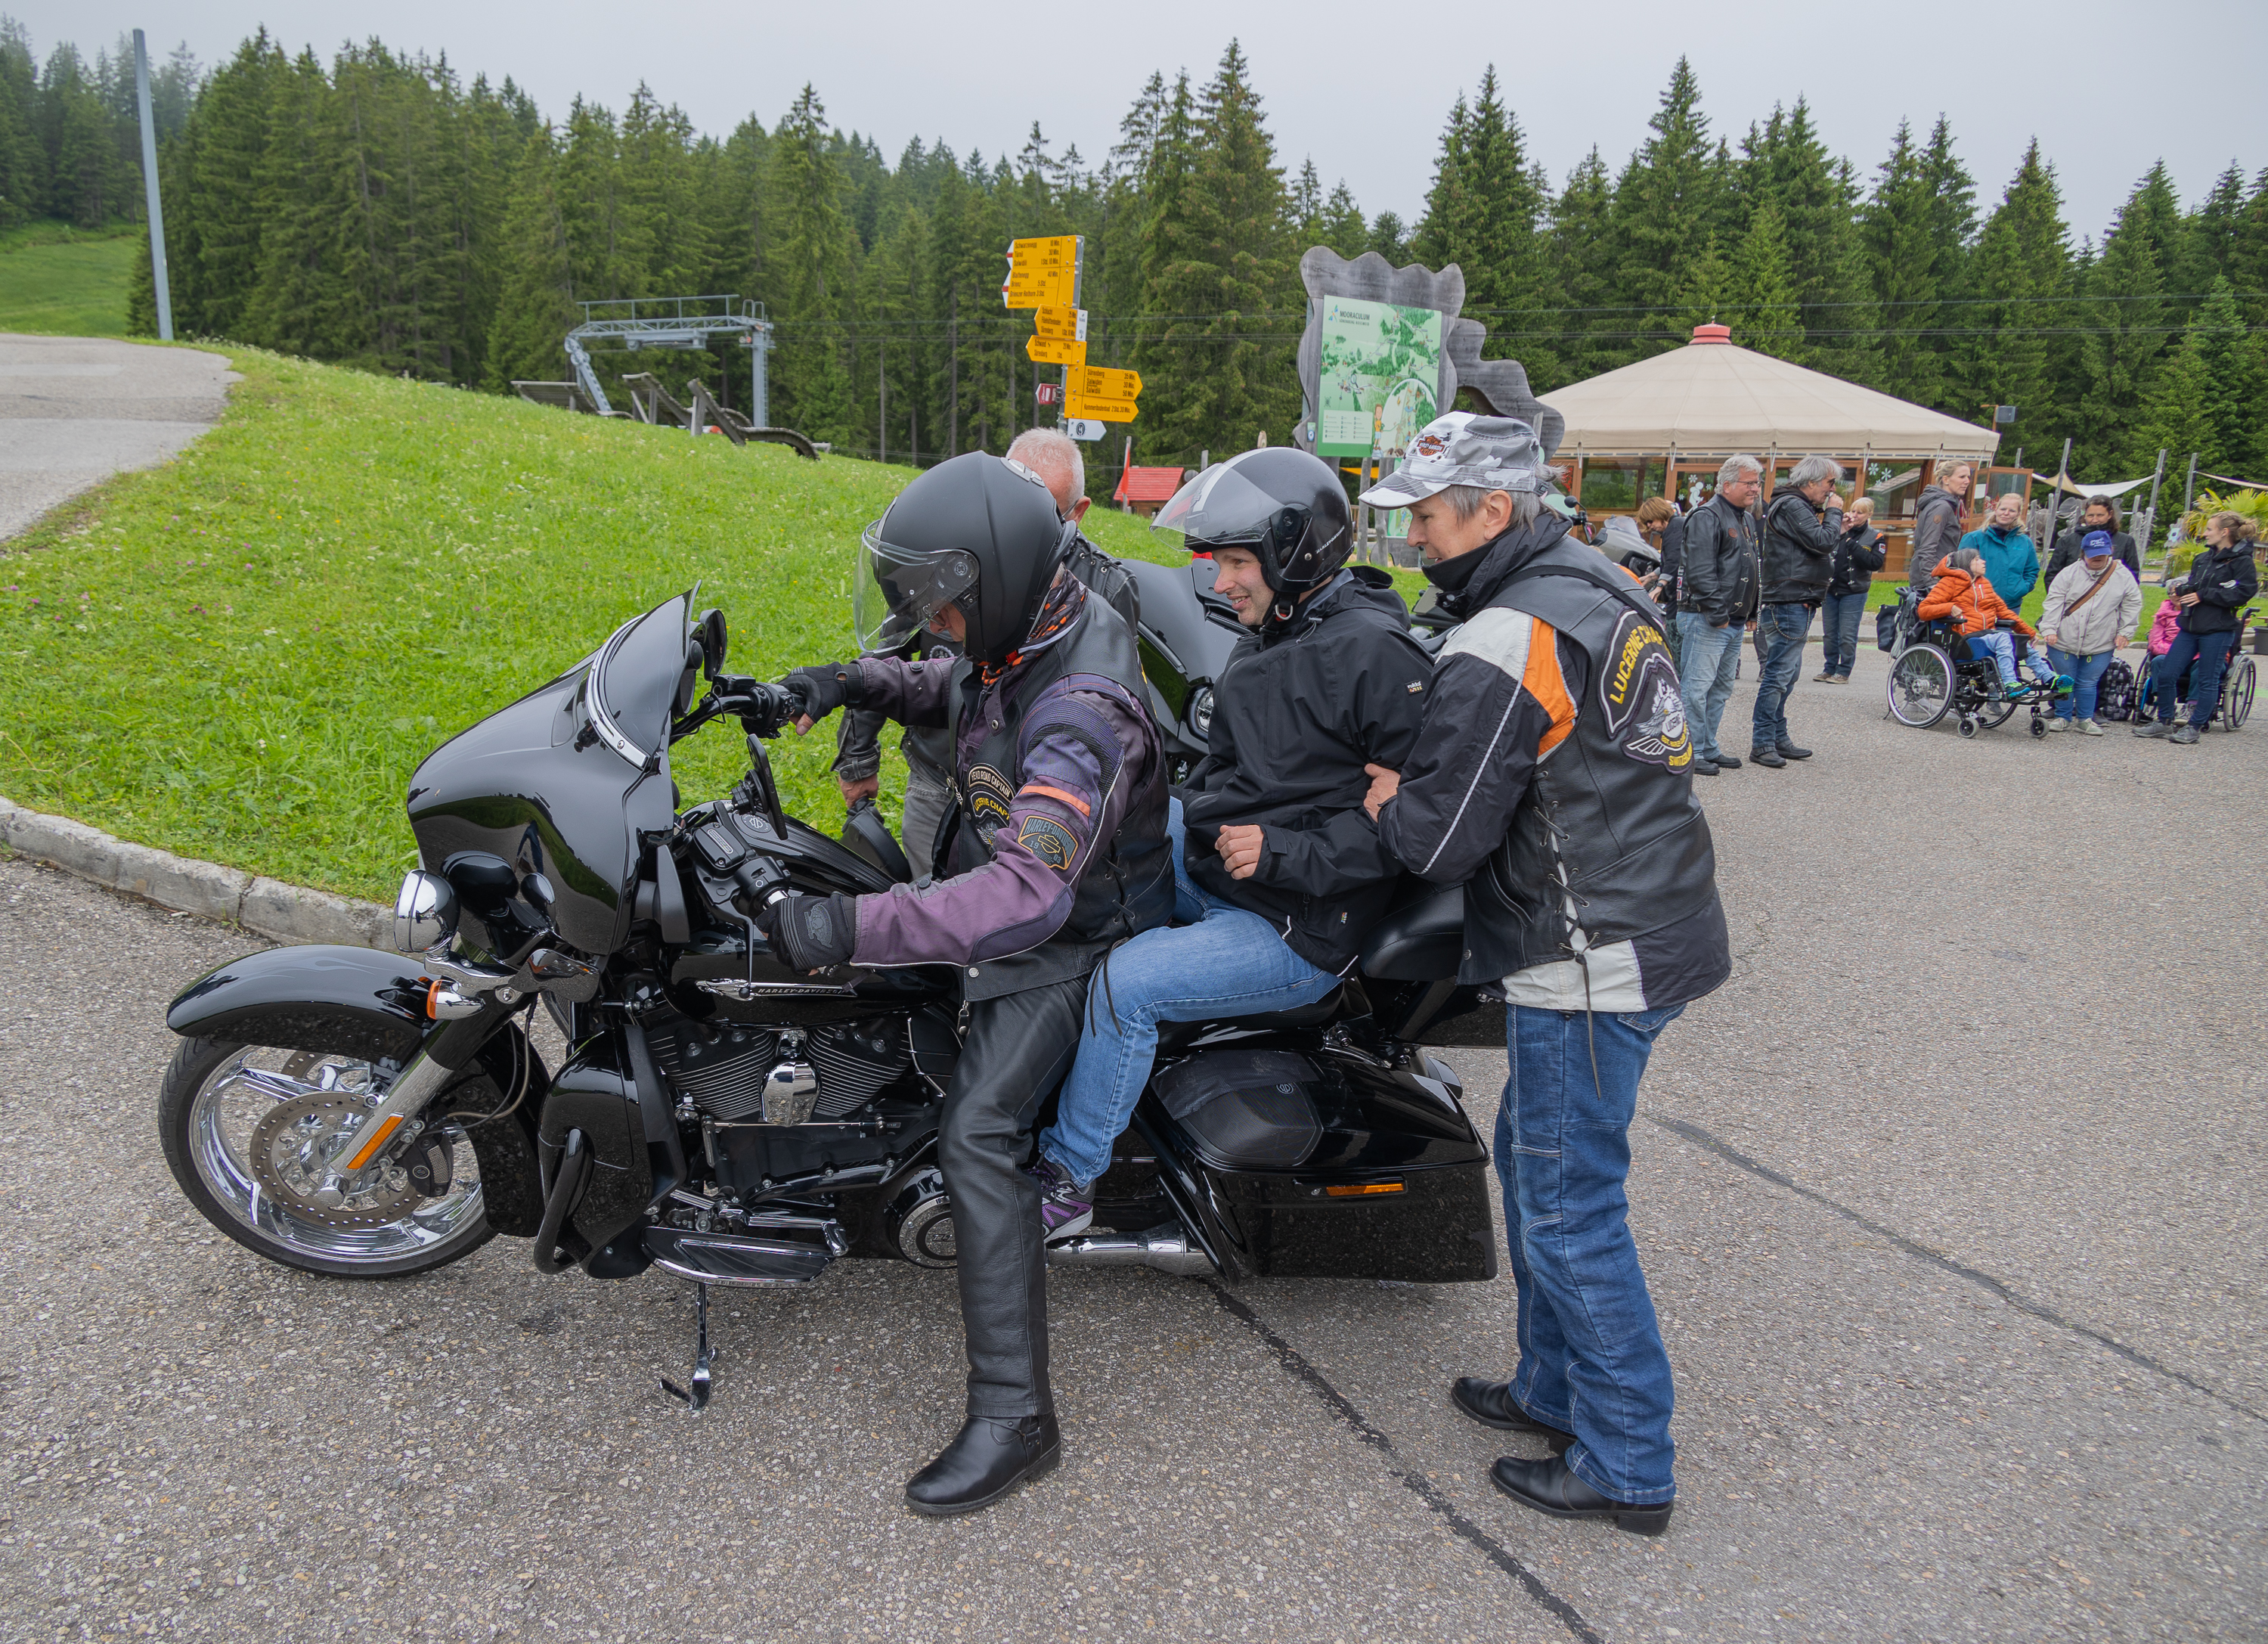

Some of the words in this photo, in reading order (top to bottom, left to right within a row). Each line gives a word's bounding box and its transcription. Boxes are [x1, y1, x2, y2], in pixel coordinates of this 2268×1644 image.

[1340, 310, 1370, 320] MOORACULUM
[1041, 326, 1053, 335] Sörenberg
[1034, 349, 1047, 358] Sörenberg
[1088, 369, 1105, 378] Sörenberg
[1610, 629, 1645, 704] LUCERNE
[971, 770, 980, 781] HEAD
[980, 771, 991, 782] ROAD
[991, 775, 1011, 798] CAPTAIN
[974, 797, 990, 811] LUCERNE
[990, 800, 1009, 820] CHAPT
[1023, 819, 1075, 861] HARLEY-DAVIDSON
[1029, 841, 1039, 849] 19
[1053, 854, 1062, 864] 03
